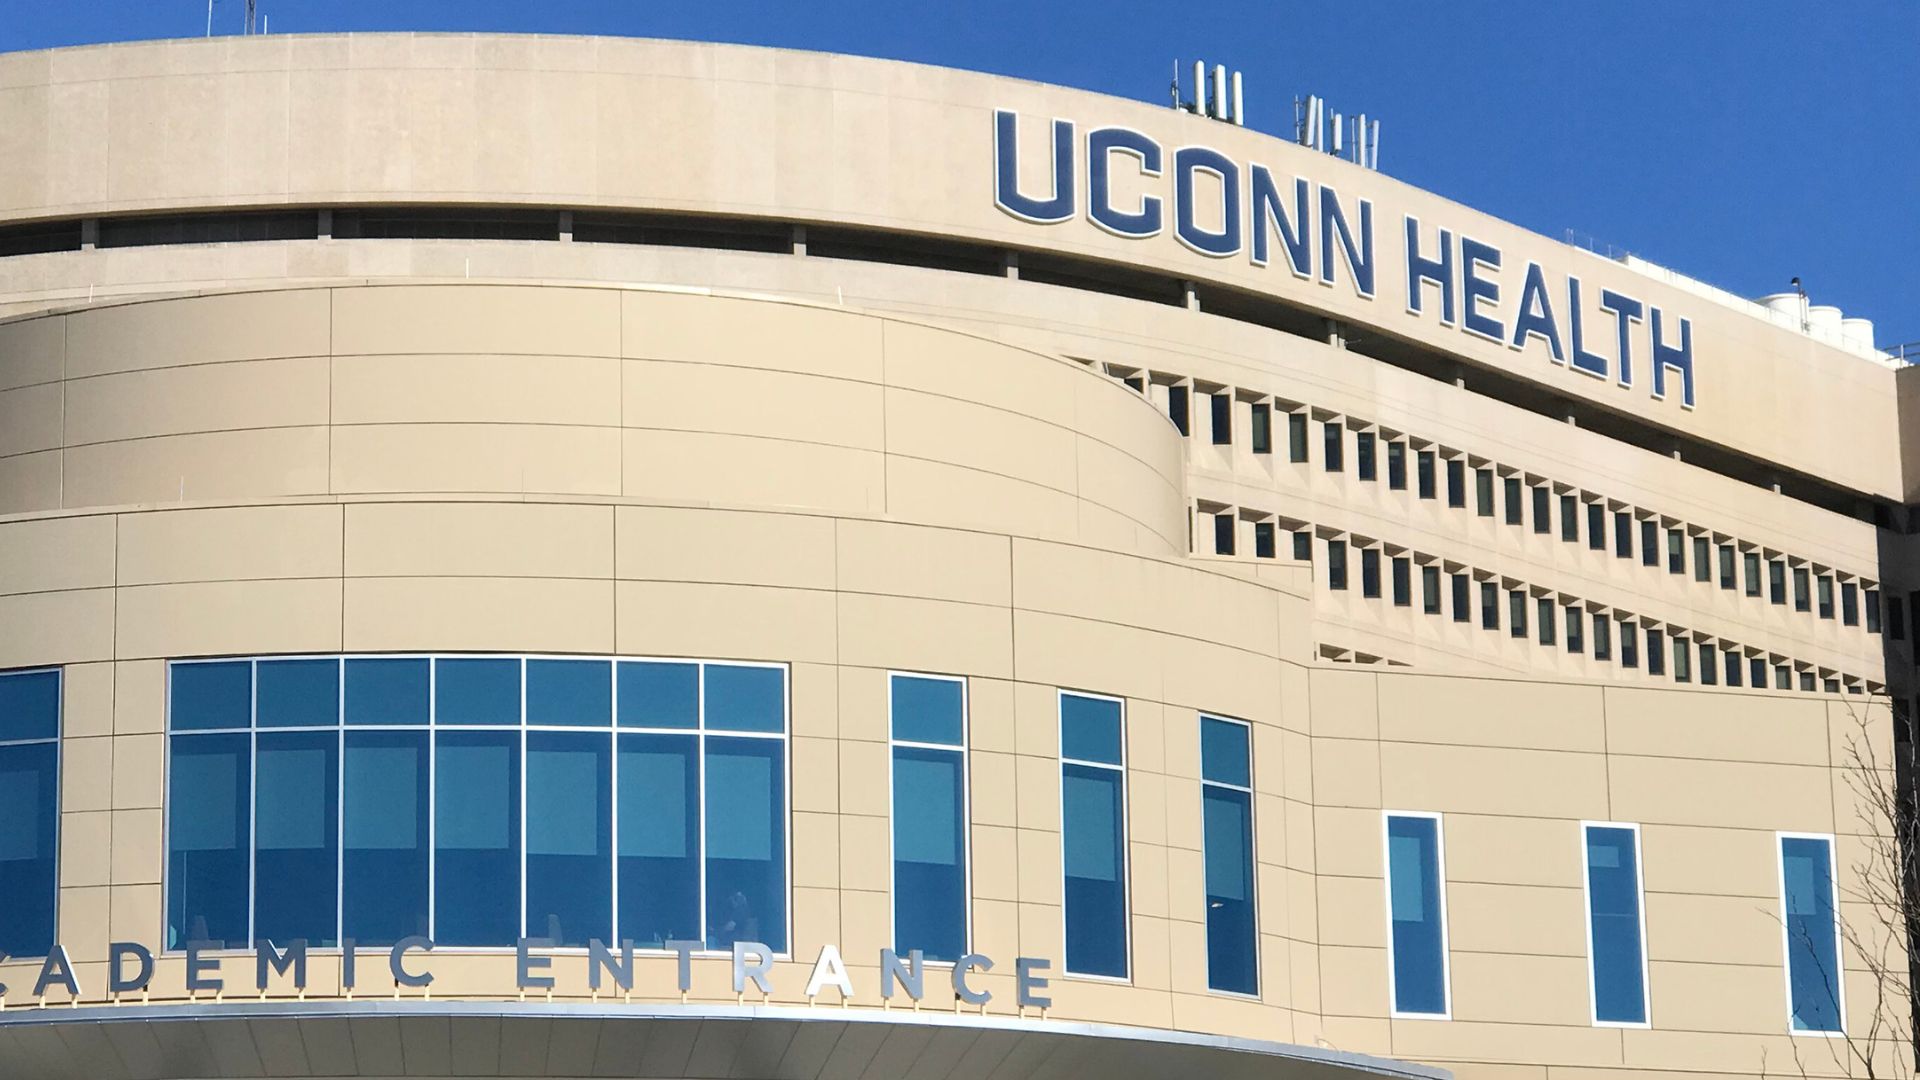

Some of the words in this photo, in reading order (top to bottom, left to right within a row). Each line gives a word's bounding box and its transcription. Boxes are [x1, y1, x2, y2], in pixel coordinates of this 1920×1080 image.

[994, 108, 1375, 299] UCONN
[1404, 213, 1696, 410] HEALTH
[0, 936, 435, 997] ADEMIC
[516, 937, 1052, 1008] ENTRANCE
